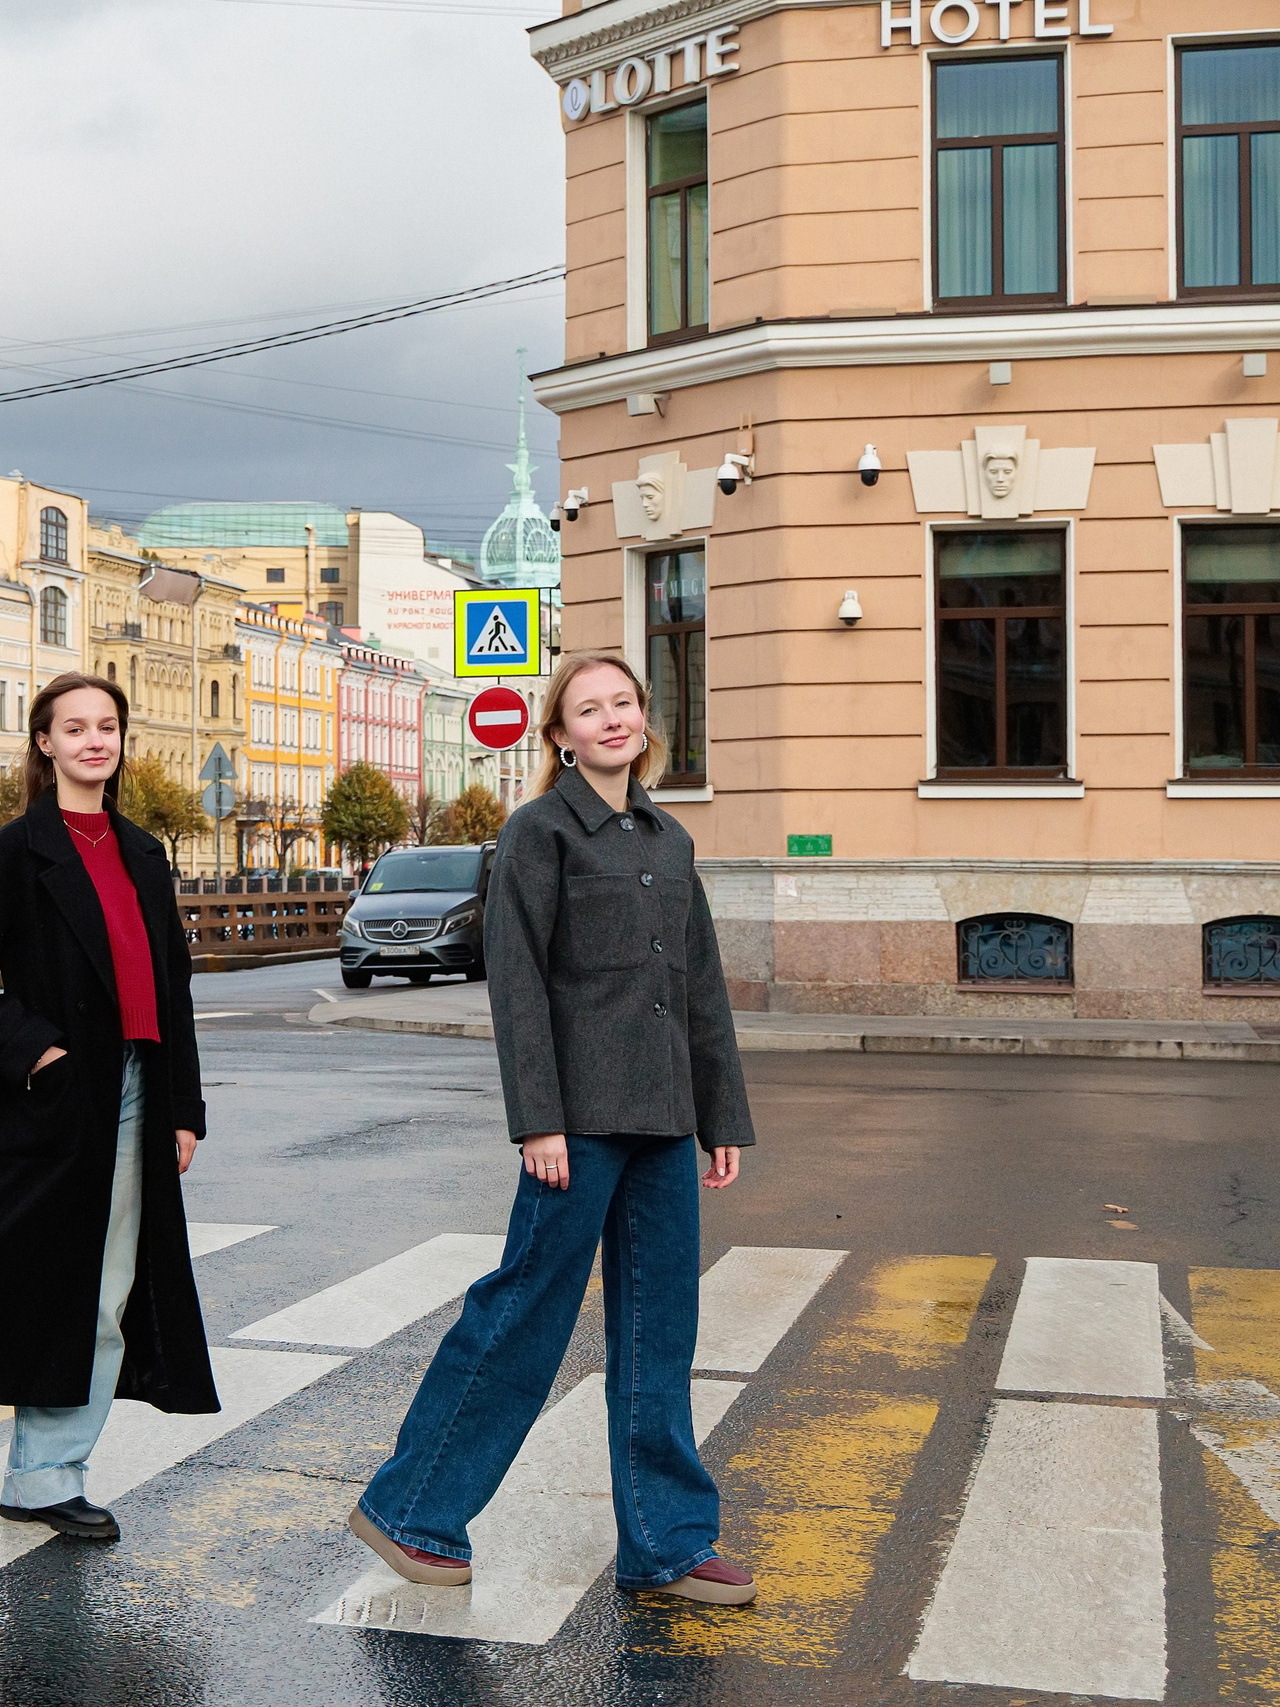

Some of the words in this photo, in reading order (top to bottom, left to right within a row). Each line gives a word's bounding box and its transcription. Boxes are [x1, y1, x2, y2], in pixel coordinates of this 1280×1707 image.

[881, 0, 1114, 47] HOTEL
[590, 25, 740, 114] LOTTE
[387, 590, 454, 601] УНИВЕРМА
[432, 622, 454, 630] МОСТ
